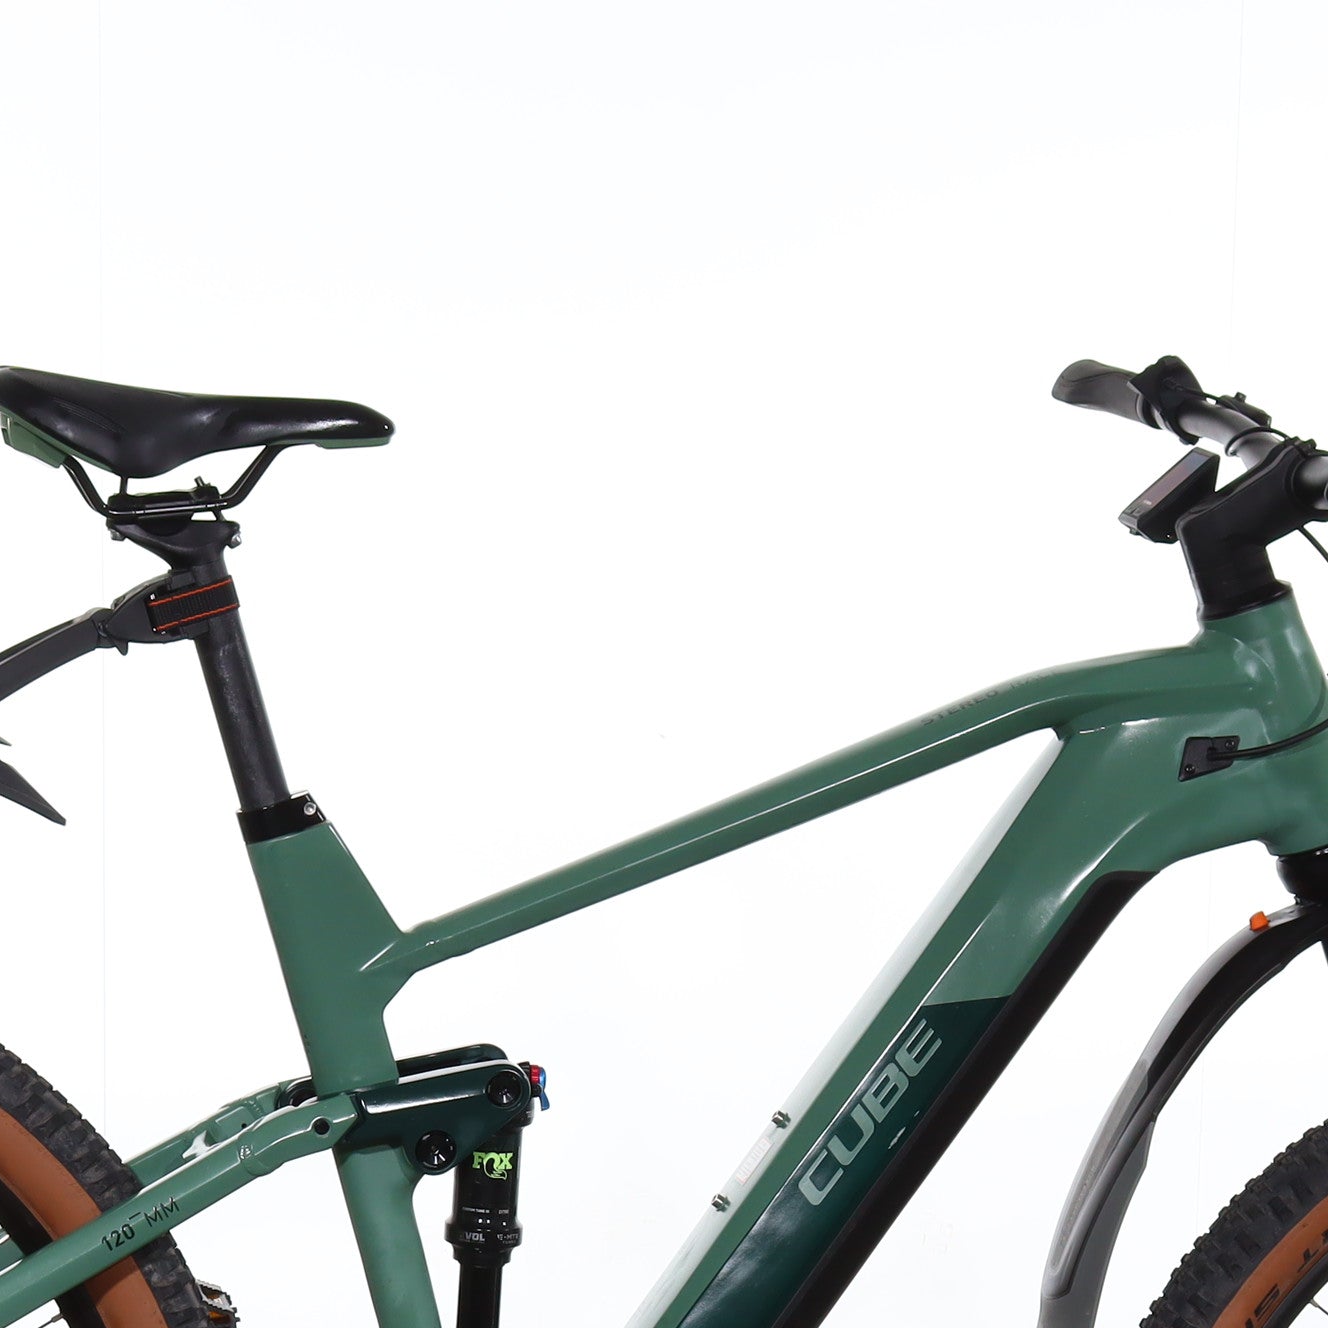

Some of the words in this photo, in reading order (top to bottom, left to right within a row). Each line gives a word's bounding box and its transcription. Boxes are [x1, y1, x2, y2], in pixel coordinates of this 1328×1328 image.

[798, 1018, 942, 1206] CUBE
[472, 1151, 514, 1180] FOX
[101, 1223, 135, 1251] 120
[144, 1197, 180, 1227] MM
